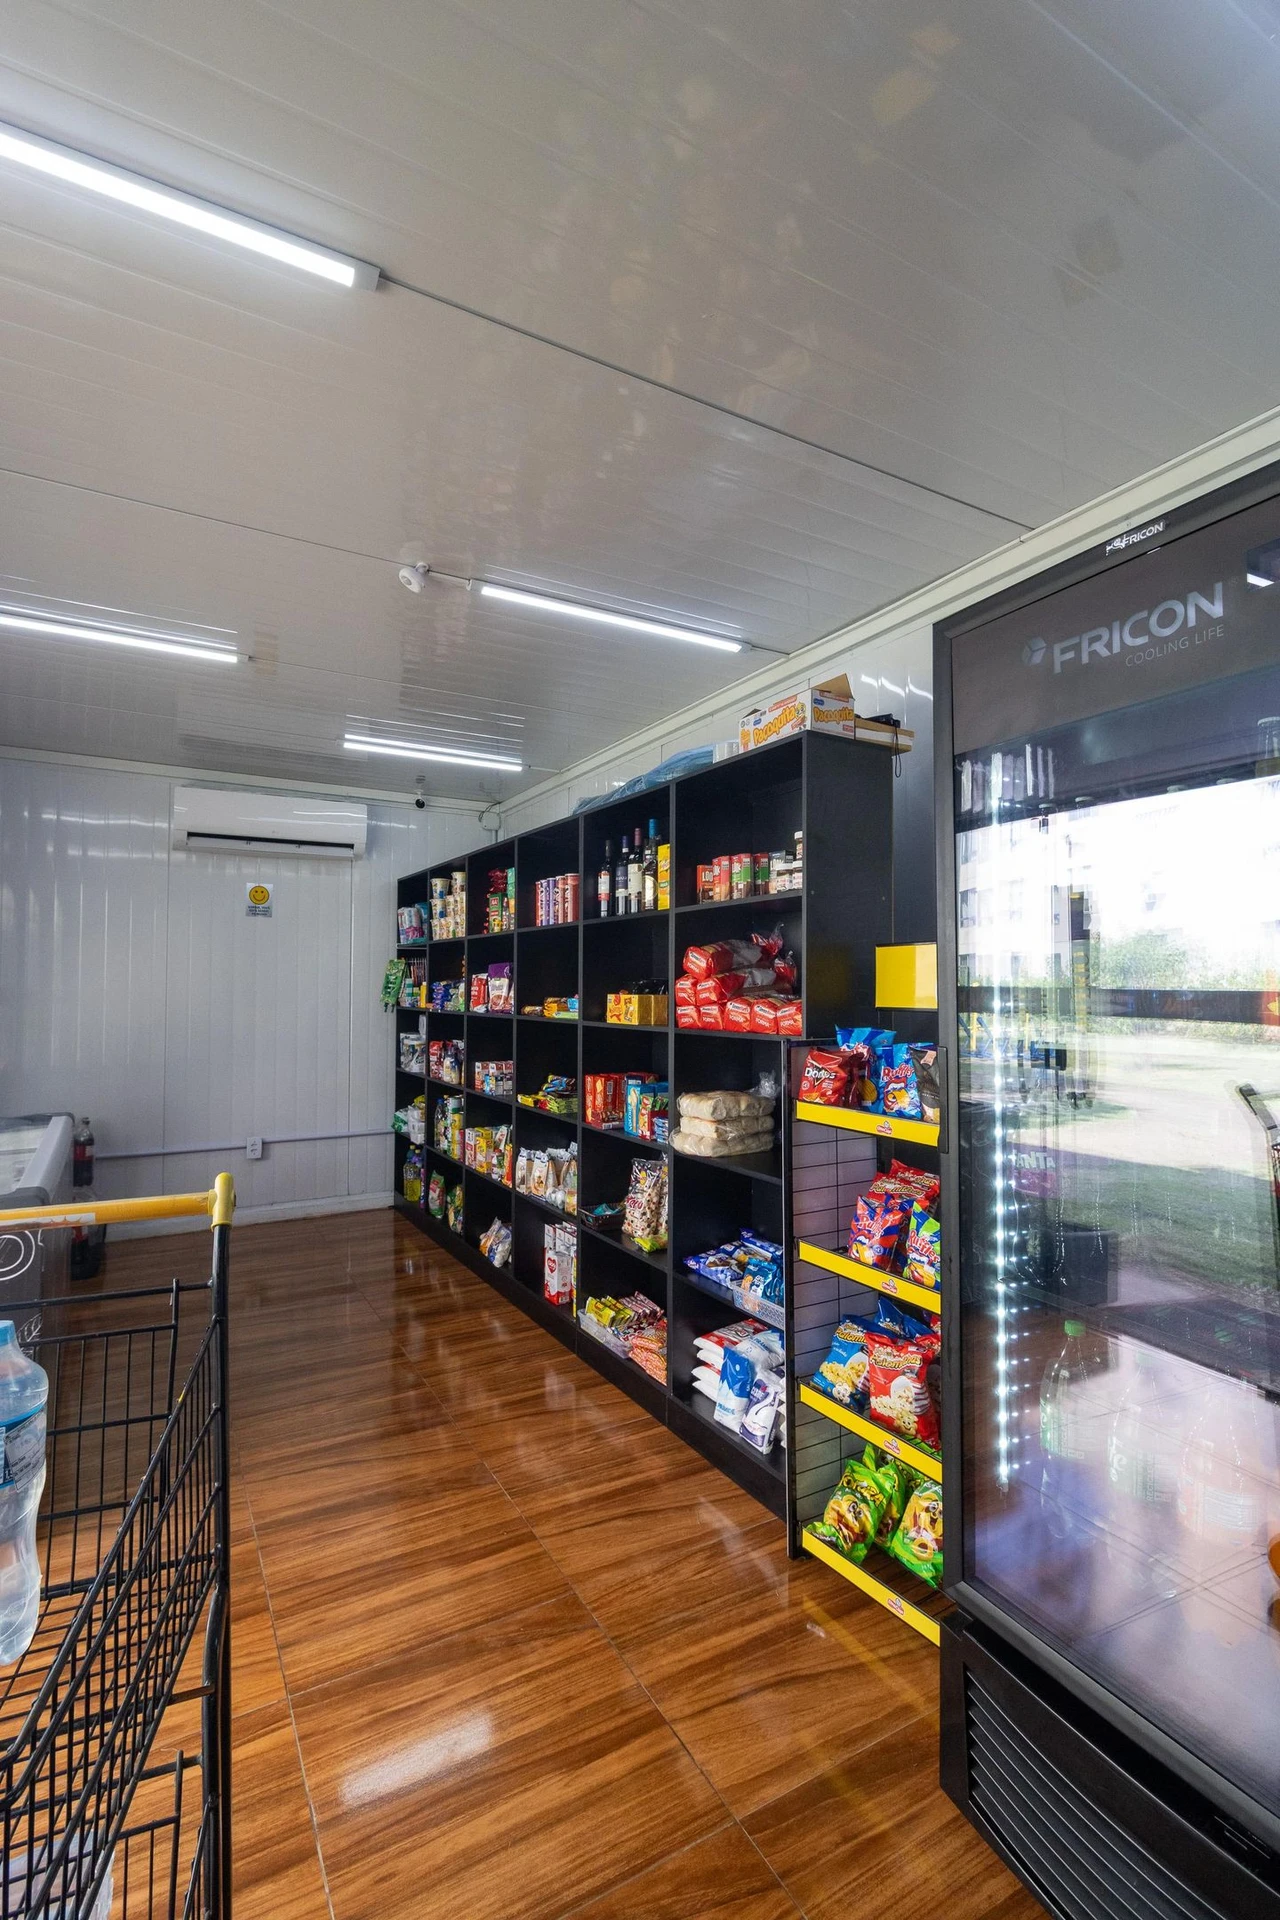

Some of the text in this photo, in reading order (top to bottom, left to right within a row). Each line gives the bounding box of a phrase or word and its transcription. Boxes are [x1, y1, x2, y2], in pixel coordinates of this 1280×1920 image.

[1053, 582, 1224, 674] FRICON
[1125, 625, 1225, 667] COOLING LIFE
[804, 1067, 836, 1080] Doritos
